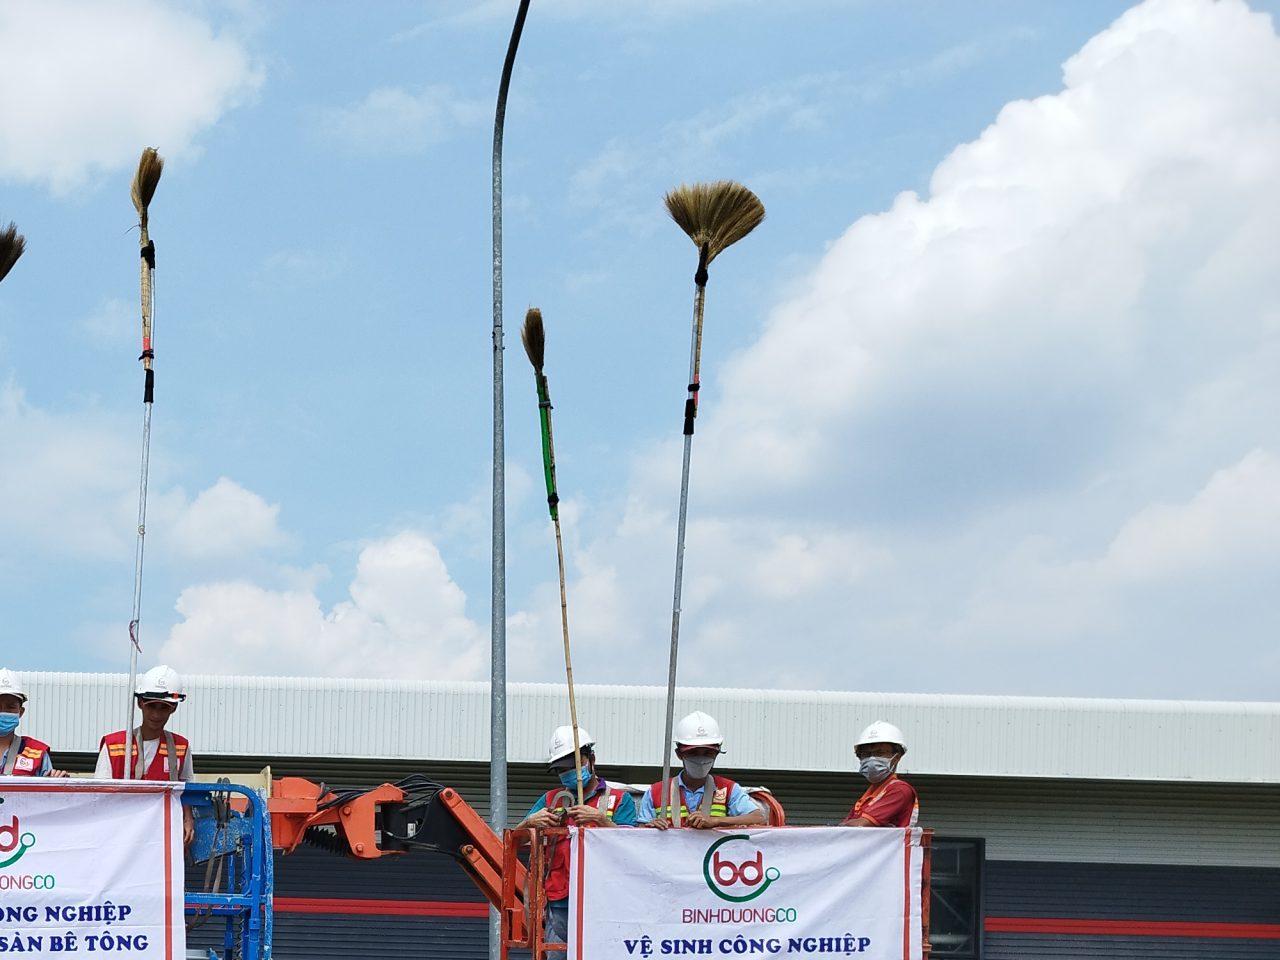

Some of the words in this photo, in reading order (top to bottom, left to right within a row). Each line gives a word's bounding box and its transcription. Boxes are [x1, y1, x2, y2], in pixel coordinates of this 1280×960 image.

[45, 900, 132, 925] NGHIỆP
[682, 907, 797, 924] BINHDUONGCO
[49, 930, 78, 952] BÊ
[84, 930, 149, 951] TÔNG
[623, 935, 654, 958] VỆ
[660, 939, 713, 954] SINH
[718, 934, 782, 954] CÔNG
[787, 932, 871, 956] NGHIỆP
